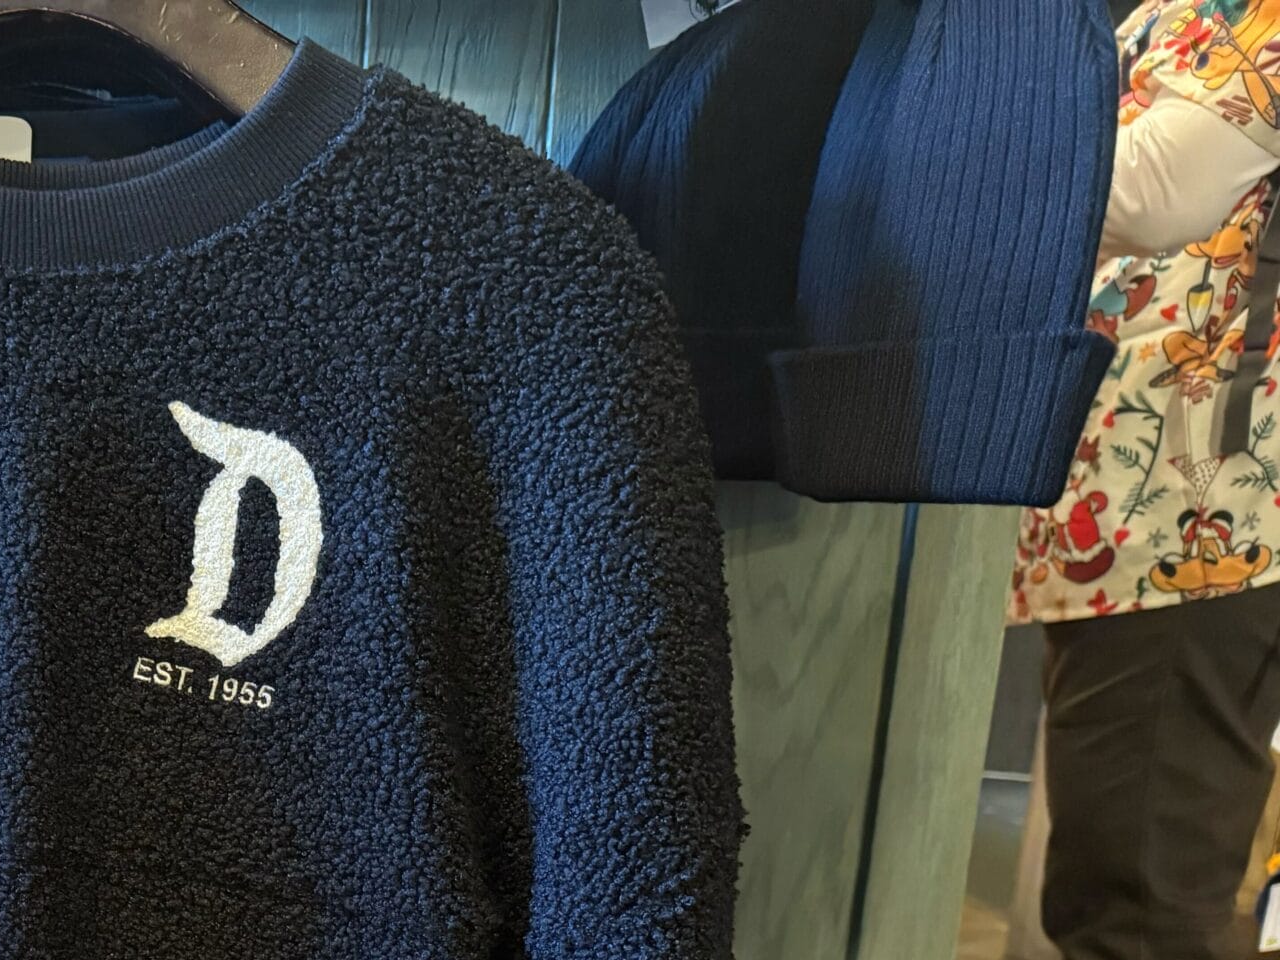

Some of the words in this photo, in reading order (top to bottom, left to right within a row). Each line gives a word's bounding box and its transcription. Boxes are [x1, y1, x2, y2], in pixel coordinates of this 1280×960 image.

[144, 401, 323, 667] D
[132, 656, 194, 693] EST.
[207, 674, 276, 710] 1955
